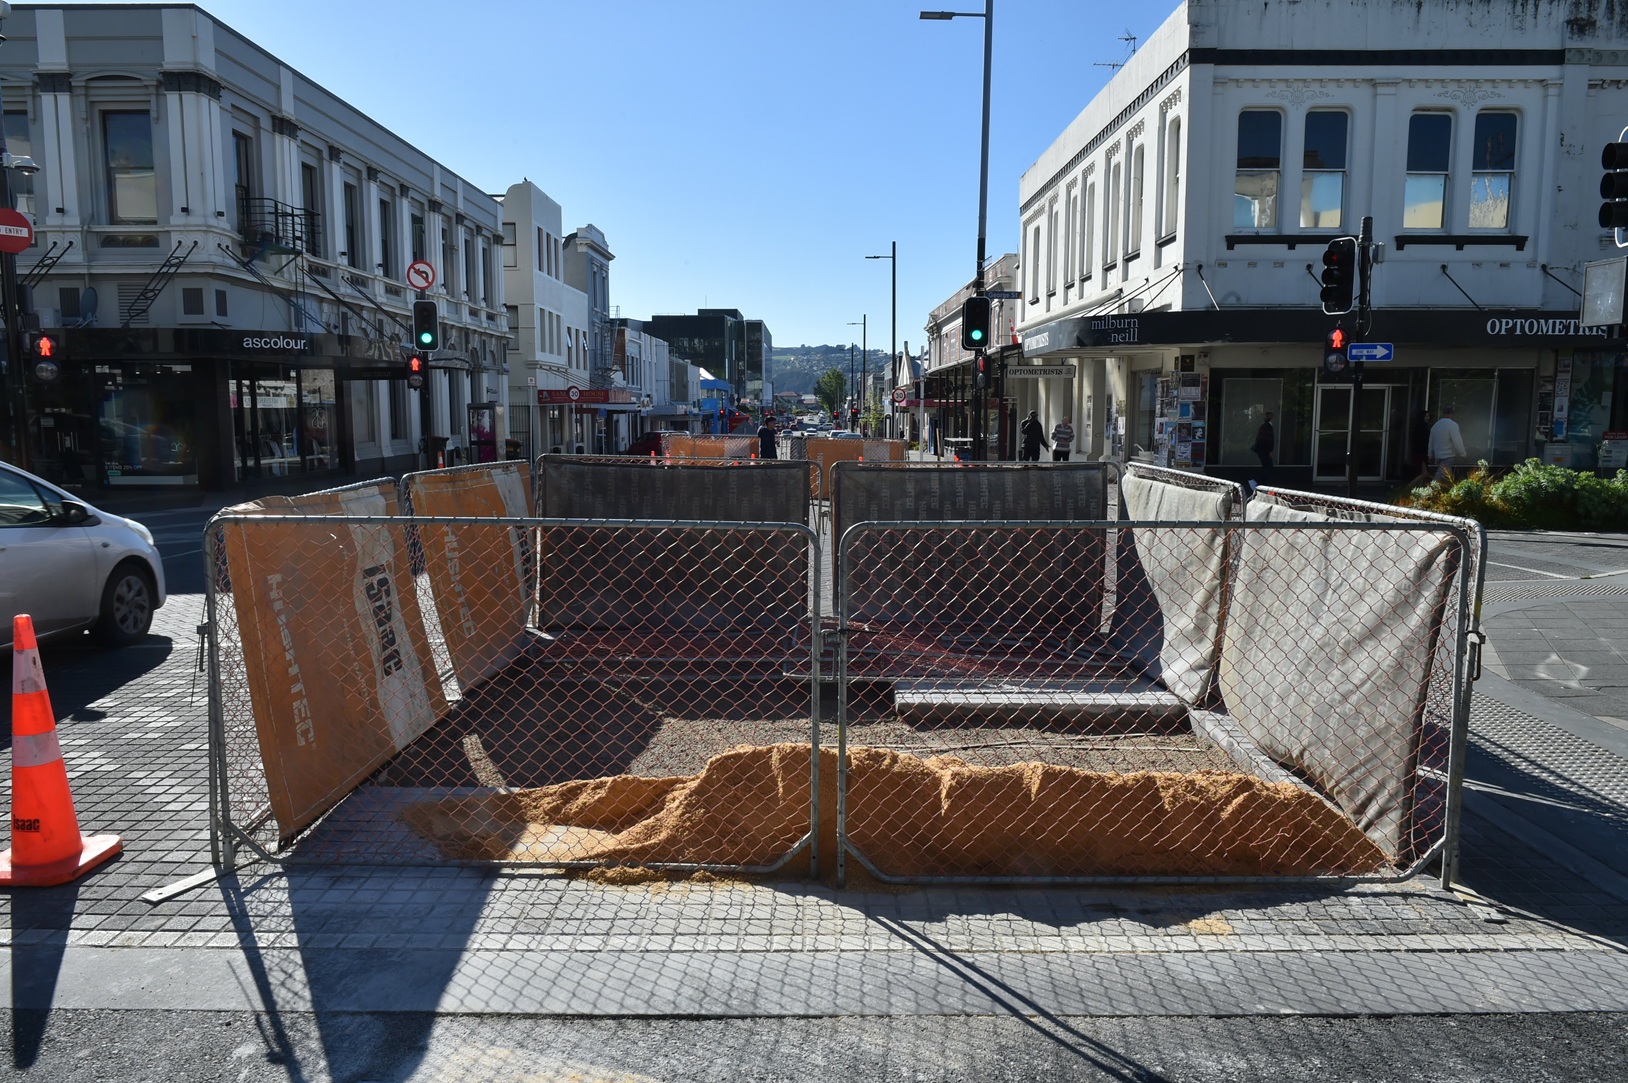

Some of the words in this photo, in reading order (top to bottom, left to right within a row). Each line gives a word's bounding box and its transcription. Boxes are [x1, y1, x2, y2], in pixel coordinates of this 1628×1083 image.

[4, 227, 23, 236] ENTRY
[988, 291, 1011, 300] George
[1091, 315, 1139, 330] milburn
[1111, 328, 1138, 343] neill
[1008, 368, 1064, 376] OPTOMETRISTS
[894, 391, 903, 399] 30
[13, 815, 40, 831] isaac
